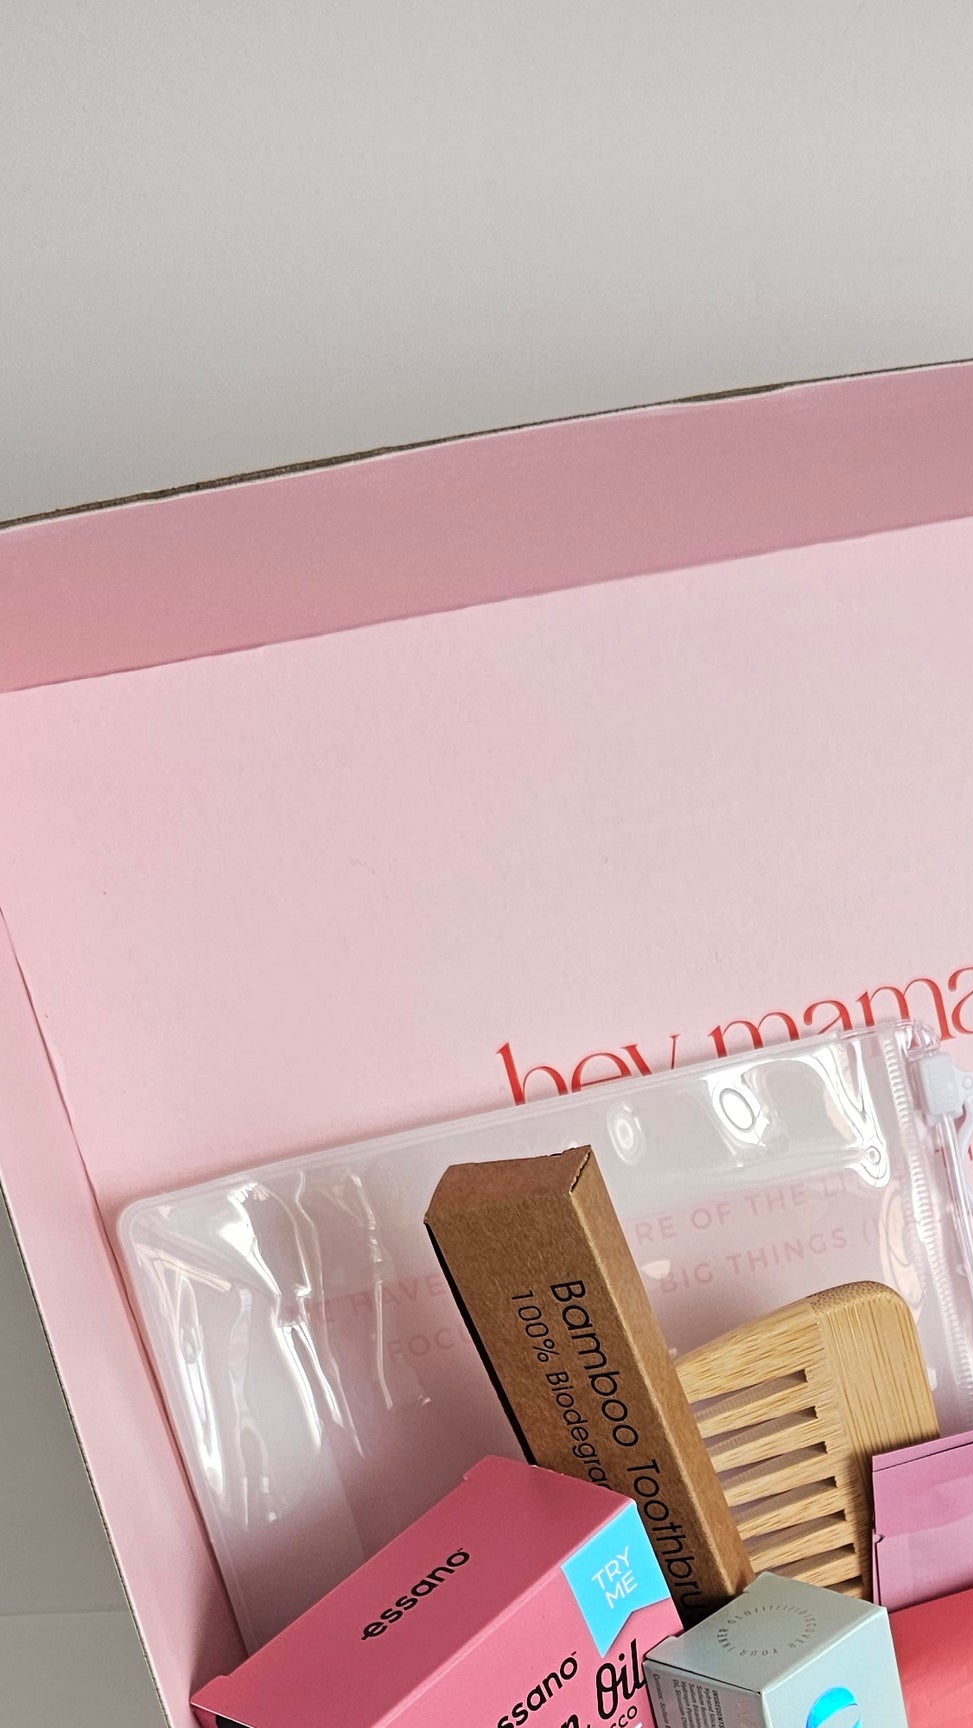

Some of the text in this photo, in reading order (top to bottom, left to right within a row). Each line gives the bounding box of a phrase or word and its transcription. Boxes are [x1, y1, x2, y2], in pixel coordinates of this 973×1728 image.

[634, 1214, 678, 1245] RE
[691, 1202, 734, 1231] OF
[748, 1183, 812, 1217] THE
[386, 1328, 471, 1365] FOC
[660, 1262, 714, 1295] BIG
[725, 1228, 849, 1275] THINGS
[511, 1290, 613, 1491] 100% Biodegra
[550, 1279, 703, 1614] Bamboo Toothbru
[360, 1548, 471, 1641] essano
[591, 1545, 632, 1590] TRY
[604, 1571, 639, 1610] ME
[594, 1638, 646, 1719] Oil
